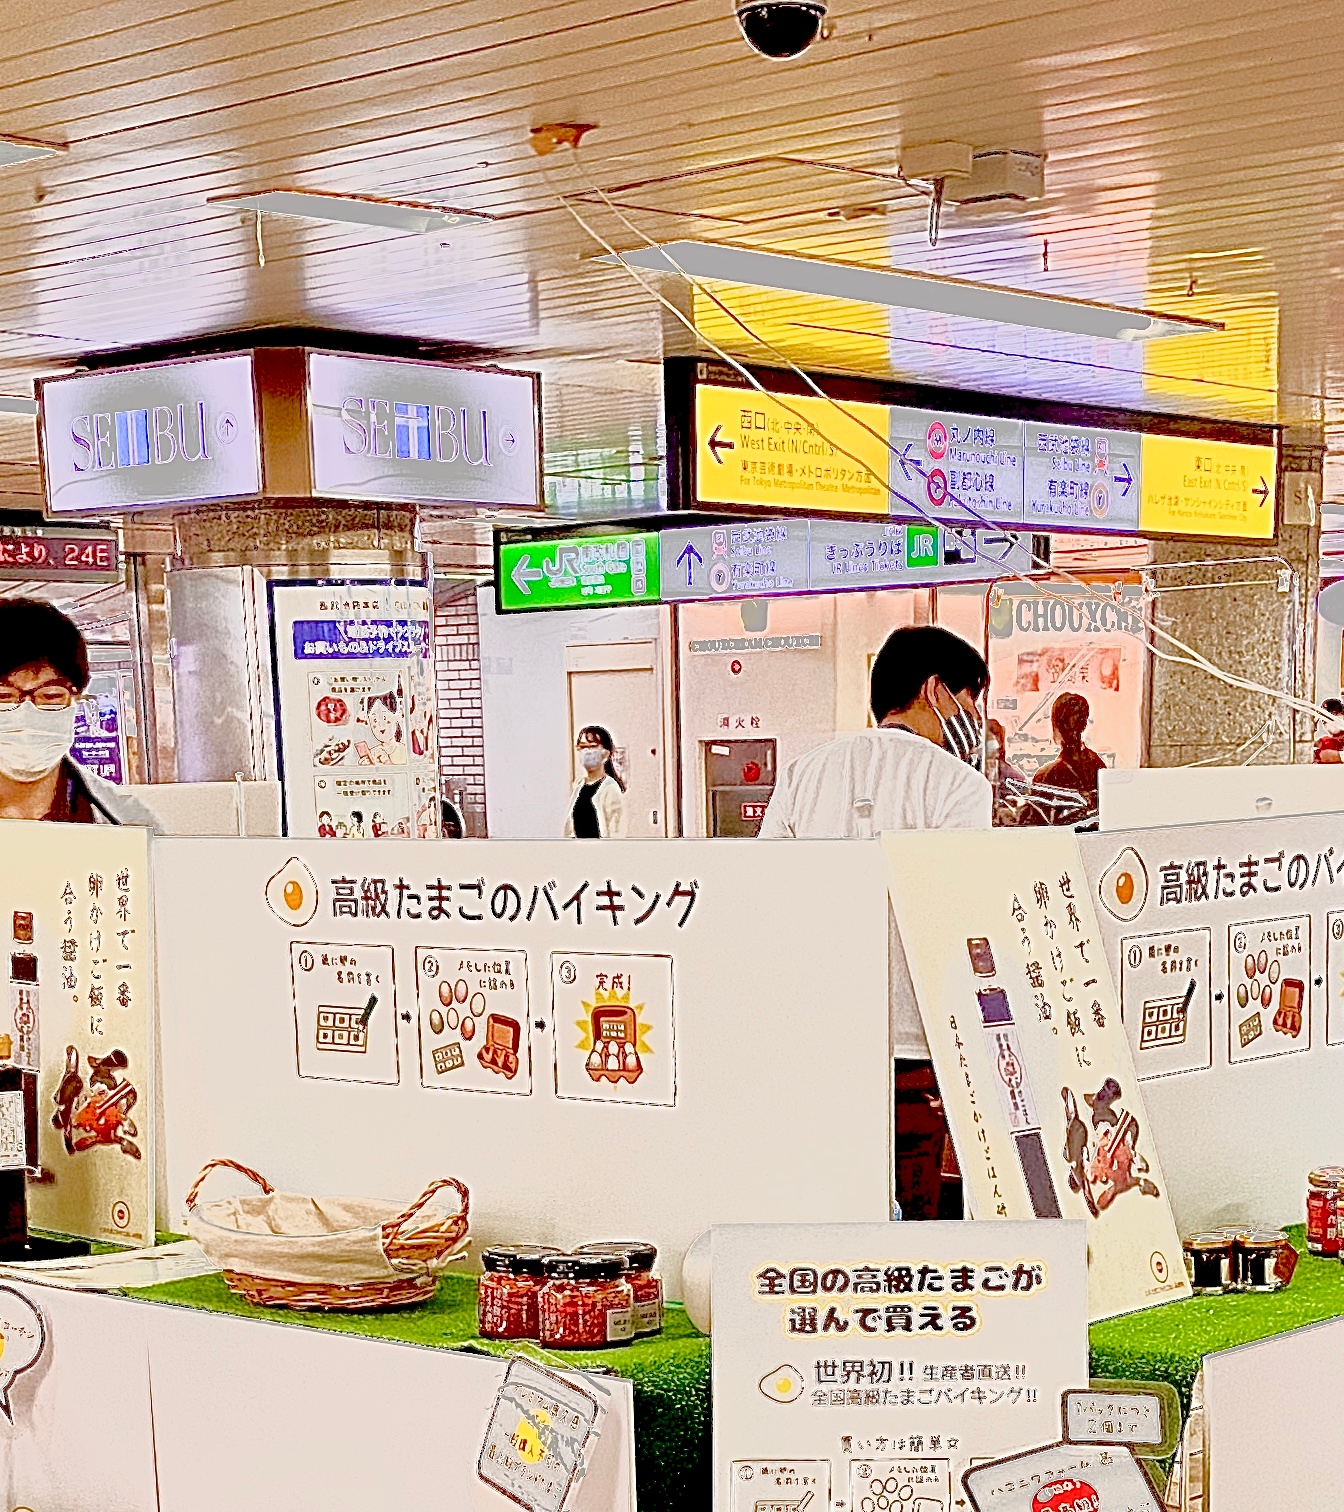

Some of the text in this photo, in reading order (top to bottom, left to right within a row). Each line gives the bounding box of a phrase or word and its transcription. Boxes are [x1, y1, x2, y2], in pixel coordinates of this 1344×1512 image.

[740, 433, 764, 450] West
[768, 438, 786, 453] Exit
[949, 426, 996, 447] 丸ノ内線
[949, 448, 1017, 467] Marunouchi Line
[1051, 457, 1091, 474] Seibu Line
[949, 470, 996, 493] 副都心線
[1047, 479, 1090, 499] 有楽町線
[1183, 475, 1198, 488] East
[1199, 476, 1213, 489] Exit
[1073, 502, 1090, 516] Line
[755, 545, 772, 556] Line
[825, 539, 903, 561] きっぷうりば
[911, 534, 934, 558] JR
[543, 546, 580, 577] JR
[731, 559, 777, 577] 有楽町線
[775, 576, 794, 588] Line
[719, 715, 762, 729] 消火栓
[330, 876, 700, 928] 高級たまごのバイキング
[115, 867, 137, 1008] 世界で一番
[87, 873, 108, 1036] 卵かけご飯に
[1058, 870, 1107, 1029] 世界で一番
[1033, 880, 1093, 1068] 卵かけご飯に
[755, 1263, 1043, 1296] 全国の高級たまごが
[788, 1304, 977, 1335] 選んで買える
[813, 1358, 1027, 1385] 世界初!! 生産者直送!!
[810, 1386, 1039, 1407] 全国高級たまごバイキング!!
